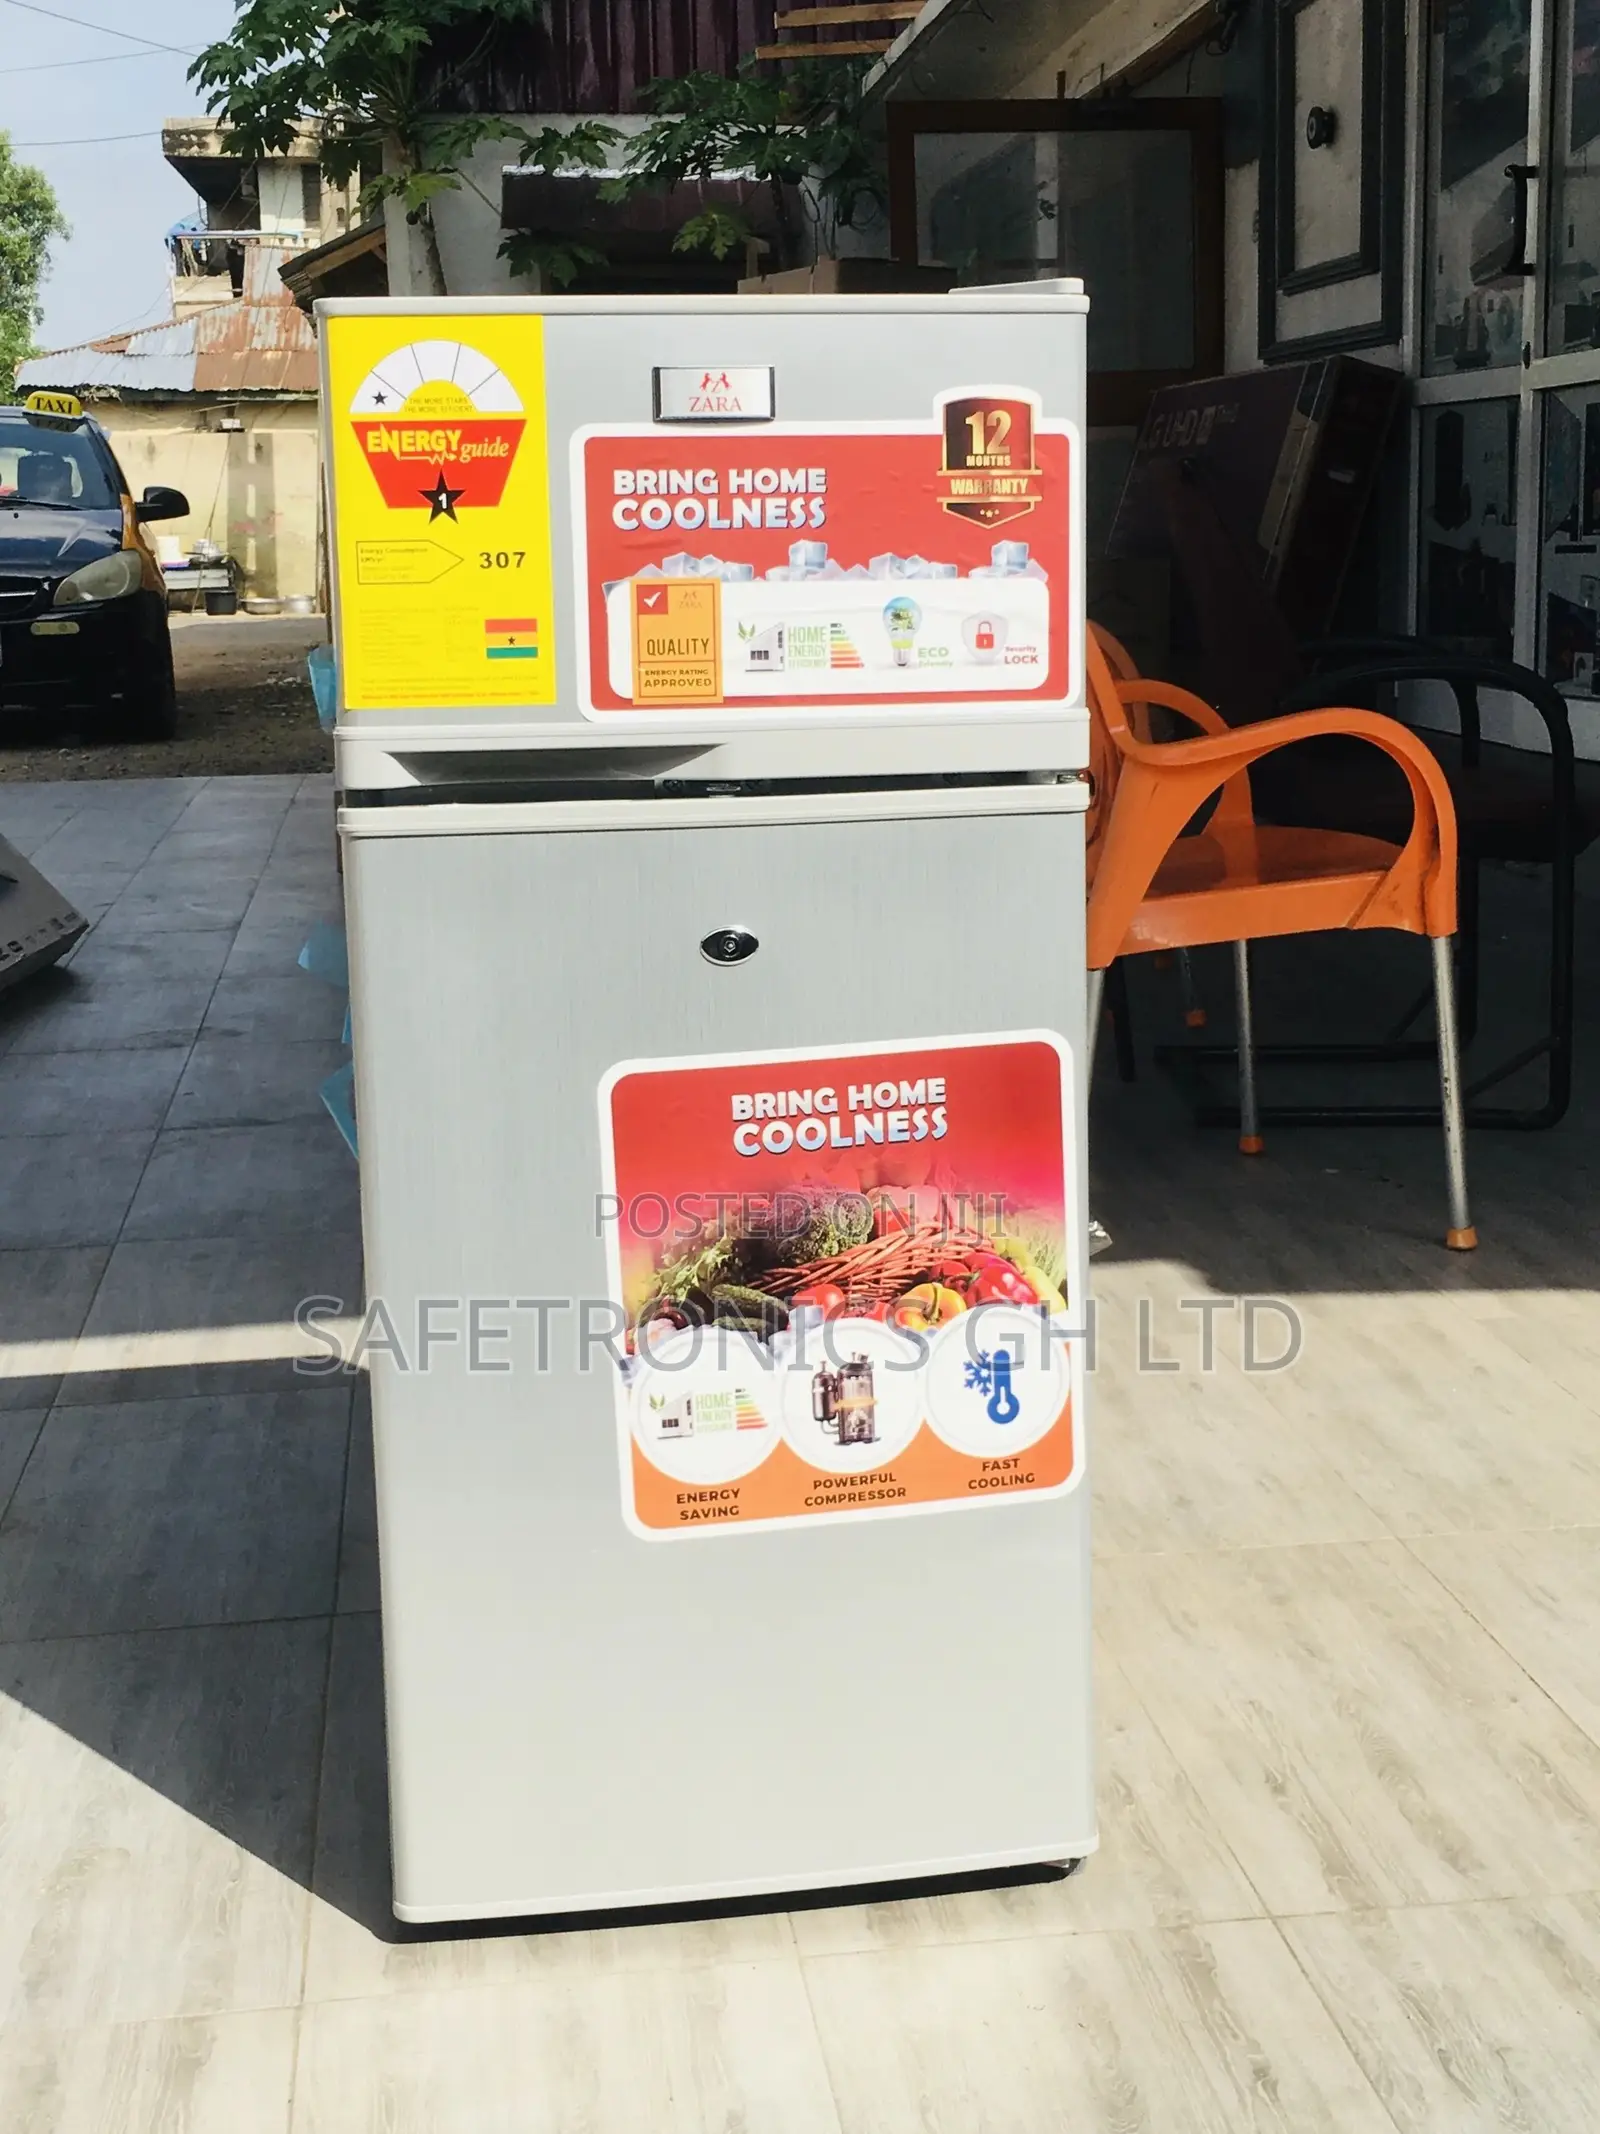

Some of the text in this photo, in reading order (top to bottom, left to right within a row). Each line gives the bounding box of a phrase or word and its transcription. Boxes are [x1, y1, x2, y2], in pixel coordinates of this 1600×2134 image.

[33, 397, 73, 414] TAXI
[424, 397, 443, 405] MORE
[688, 396, 742, 412] ZARA
[965, 410, 1012, 455] 12
[367, 423, 509, 463] ENERGY guide
[966, 455, 1011, 467] MONTHS
[613, 467, 828, 495] BRING HOME
[950, 478, 1028, 495] WARRANTY
[438, 492, 448, 509] 1
[612, 497, 827, 531] COOLNESS
[479, 551, 526, 569] 307
[788, 626, 827, 643] HOME
[646, 638, 709, 656] QUALITY
[788, 644, 827, 657] ENERGY
[918, 646, 949, 658] ECO
[1005, 645, 1037, 653] Security
[1004, 654, 1039, 665] LOCK
[645, 668, 709, 676] ENERGY RATING
[644, 678, 712, 688] APPROVED
[731, 1077, 947, 1121] BRING HOME
[733, 1106, 948, 1157] COOLNESS
[695, 1391, 733, 1410] HOME
[982, 1458, 1021, 1472] FAST
[813, 1472, 897, 1490] POWERFUL
[968, 1472, 1035, 1490] COOLING
[676, 1487, 741, 1504] ENERGY
[804, 1487, 907, 1507] COMPRESSOR
[680, 1505, 740, 1521] SAVING
